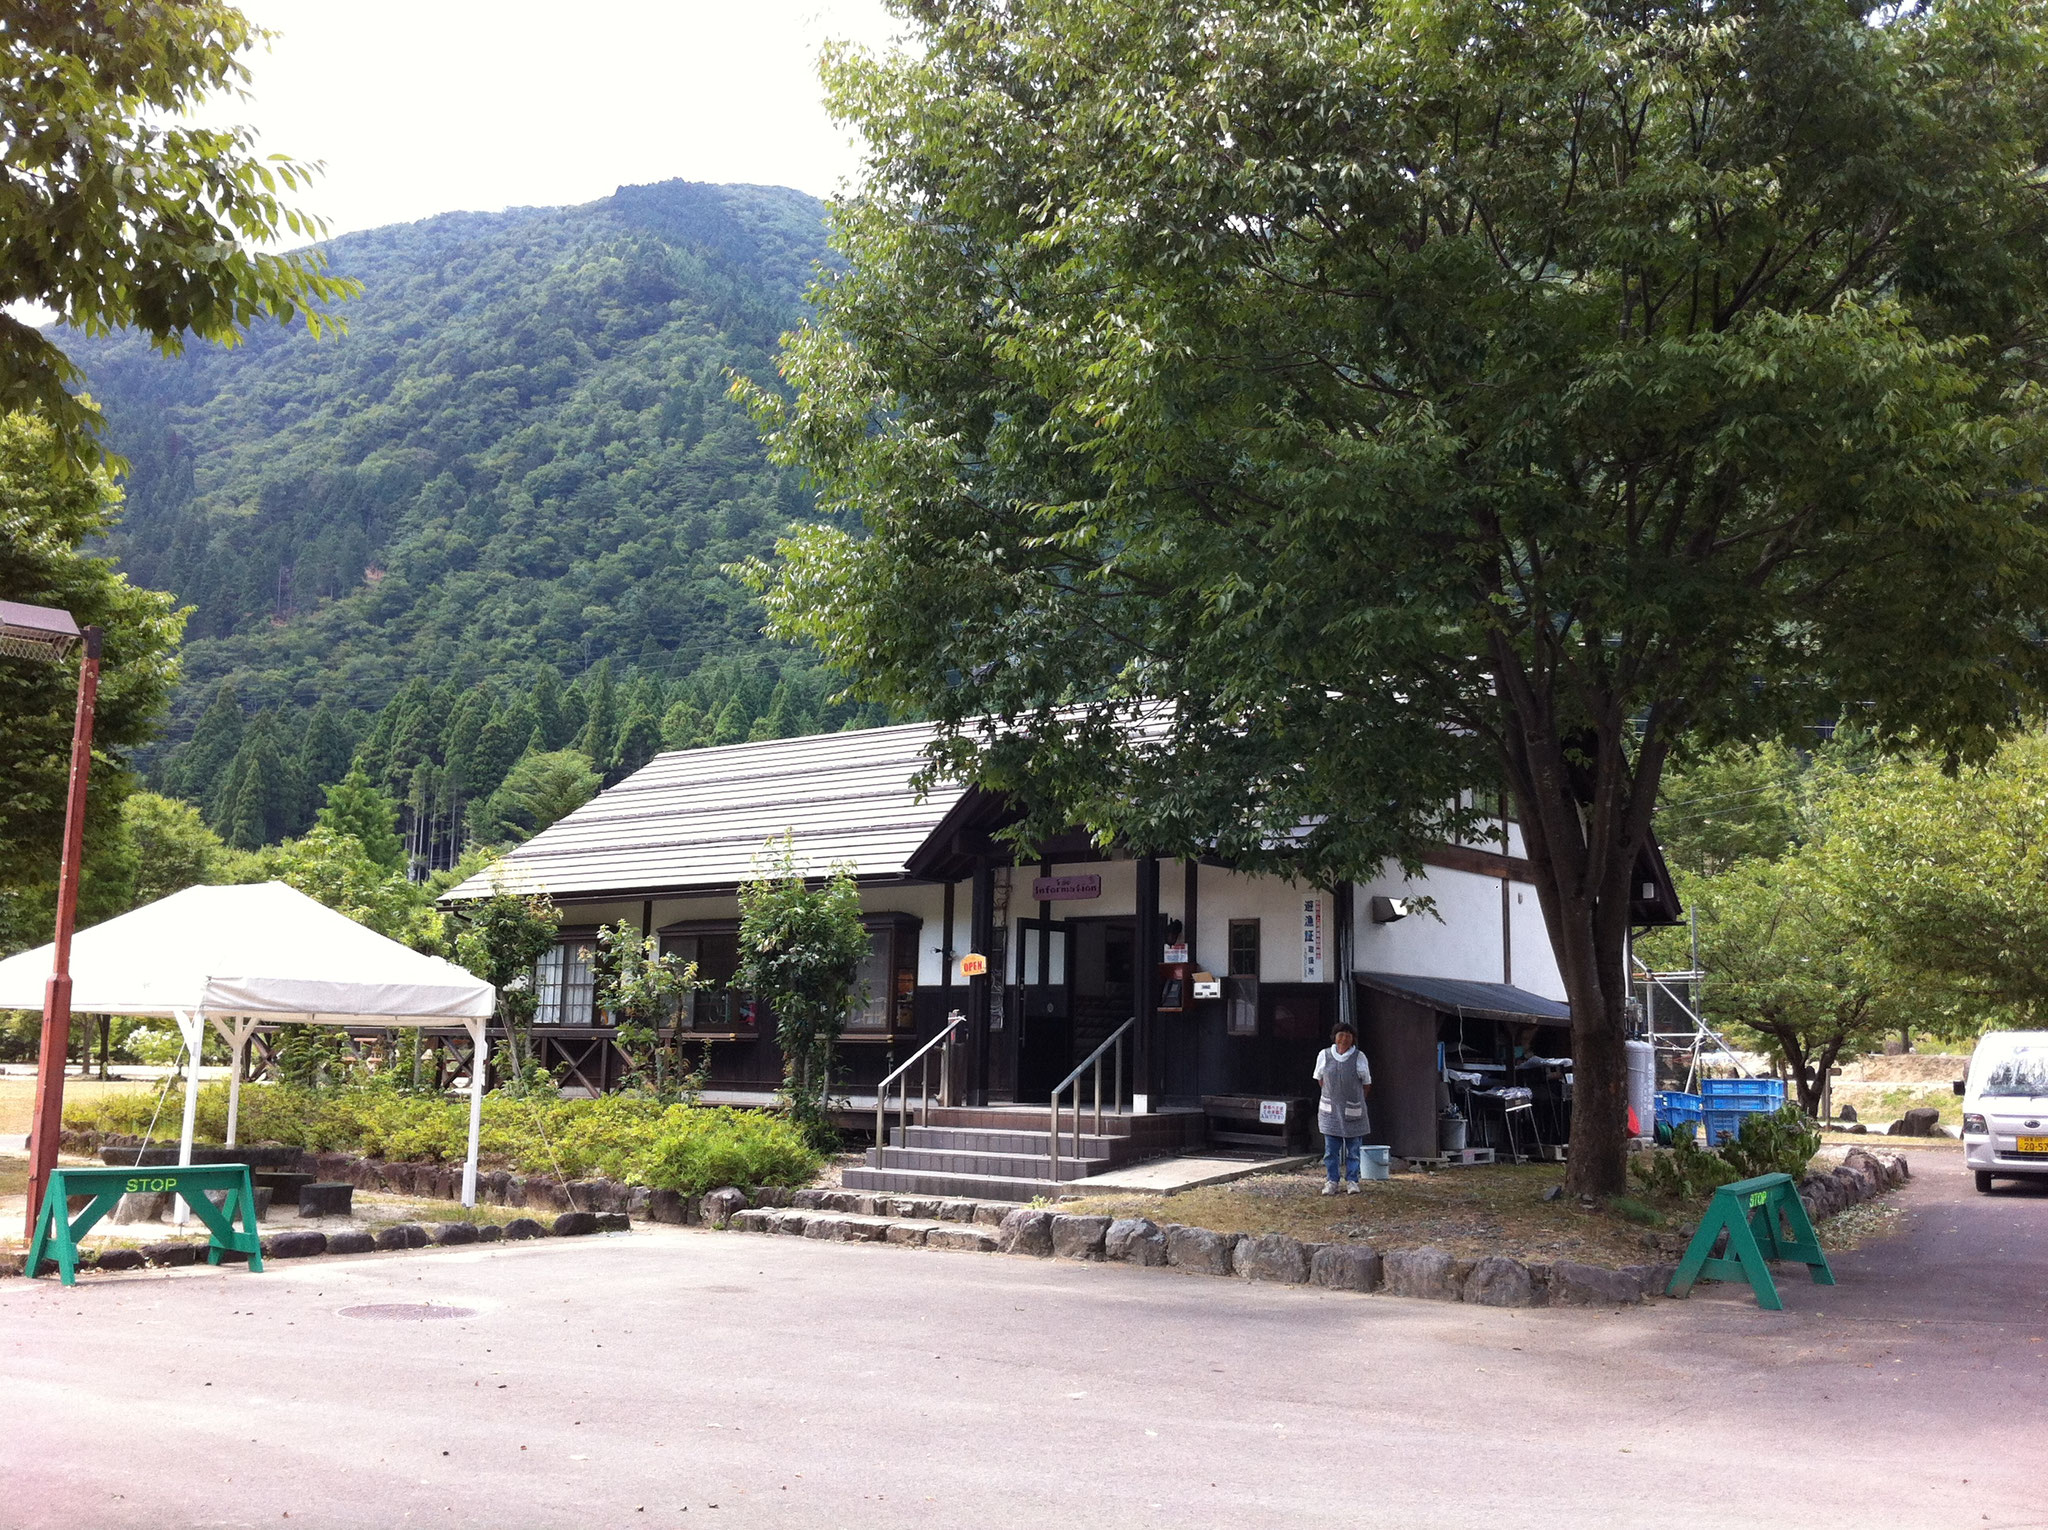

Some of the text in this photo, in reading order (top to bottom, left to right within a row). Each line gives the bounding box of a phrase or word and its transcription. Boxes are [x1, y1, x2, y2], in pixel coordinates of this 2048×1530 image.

[963, 960, 983, 972] OPEN
[125, 1178, 177, 1192] STOP
[1749, 1191, 1768, 1208] STOP
